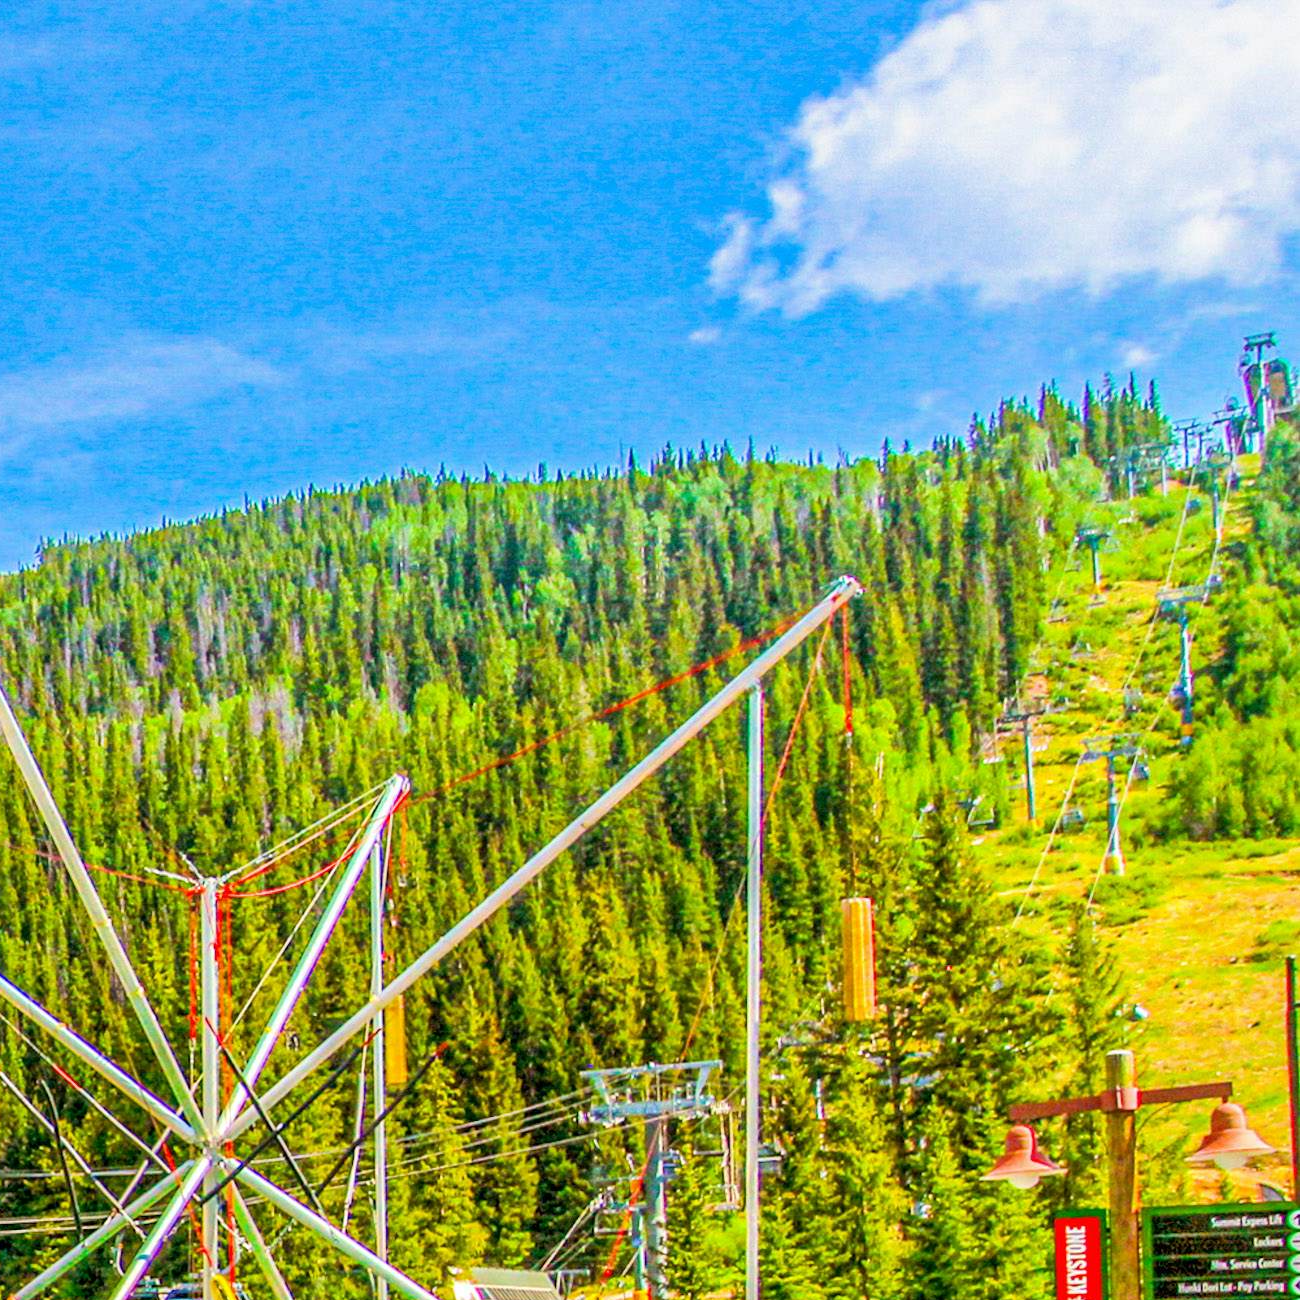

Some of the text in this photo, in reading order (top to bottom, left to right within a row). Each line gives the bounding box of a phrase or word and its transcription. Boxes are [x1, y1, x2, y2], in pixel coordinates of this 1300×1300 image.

[1065, 1225, 1087, 1295] KEYSTONE
[1230, 1259, 1257, 1269] Service
[1258, 1258, 1284, 1268] Center
